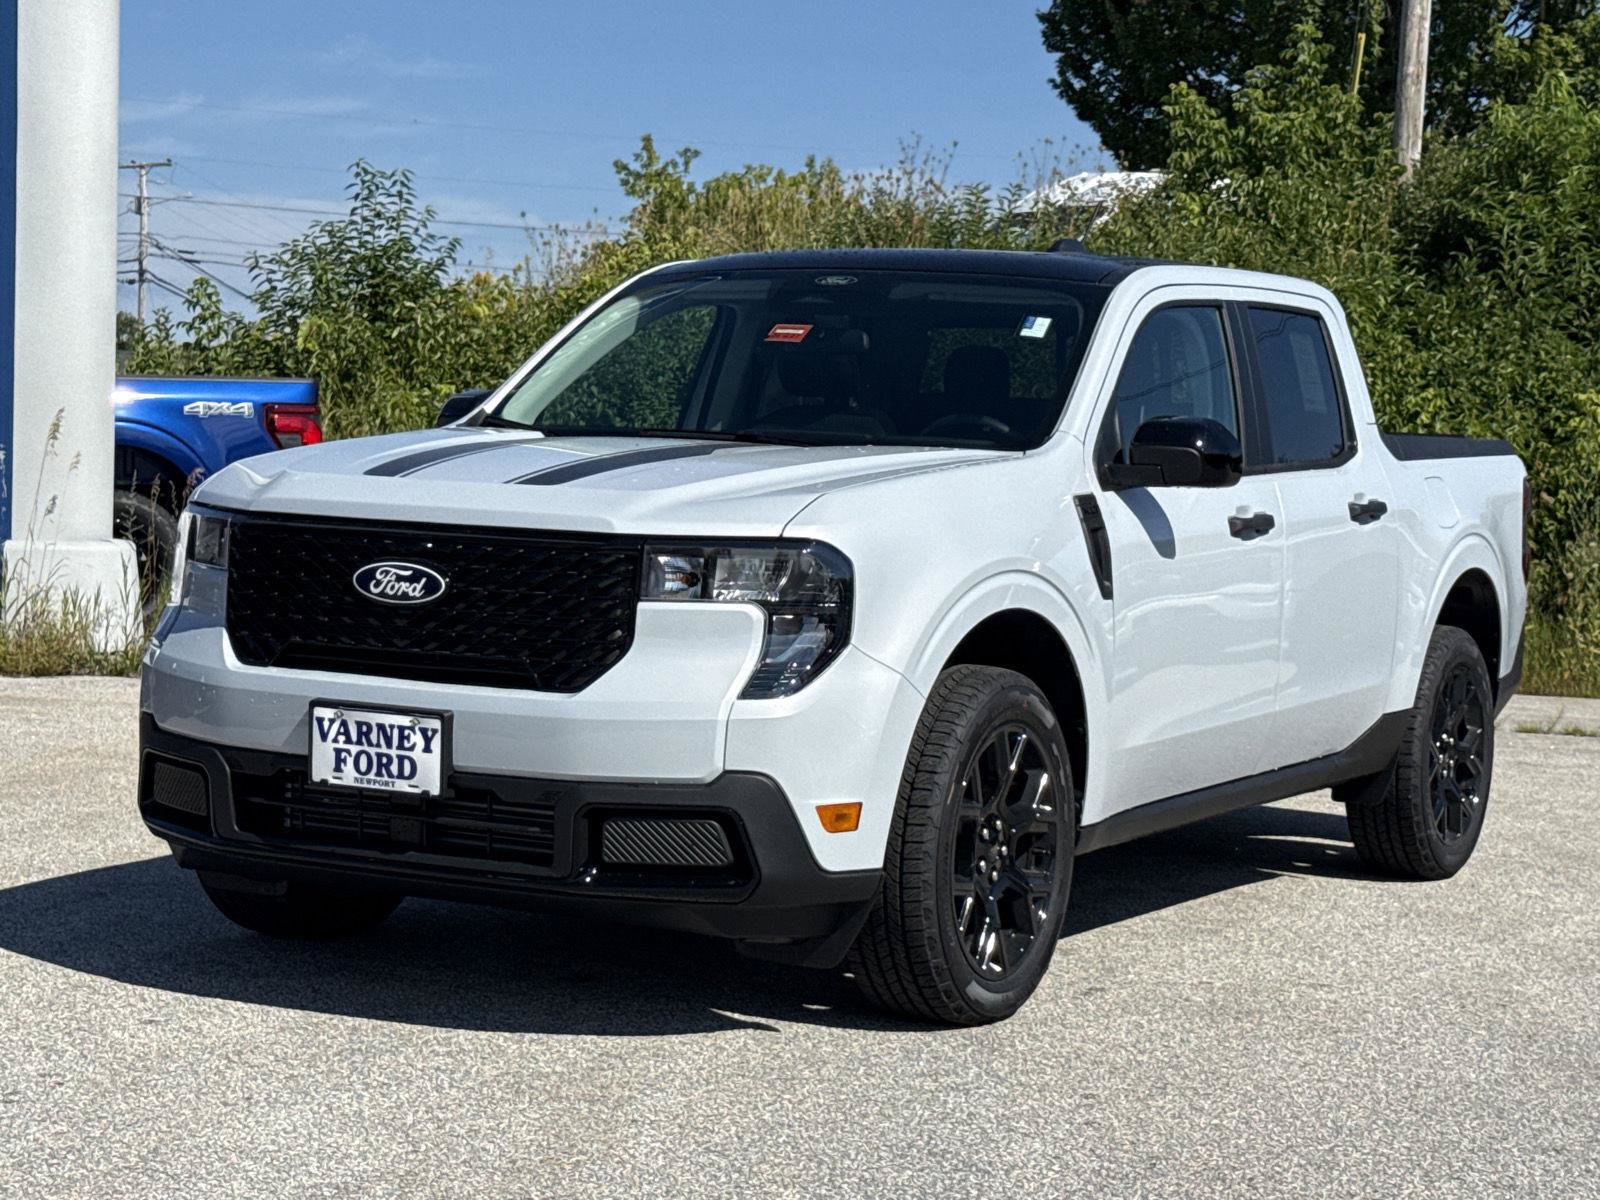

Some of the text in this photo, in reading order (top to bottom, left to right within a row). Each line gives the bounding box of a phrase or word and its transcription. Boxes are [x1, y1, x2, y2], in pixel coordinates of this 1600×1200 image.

[369, 566, 427, 597] Ford
[315, 716, 439, 754] VARNEY
[332, 747, 418, 780] FORD
[353, 776, 396, 788] NEWPORT
